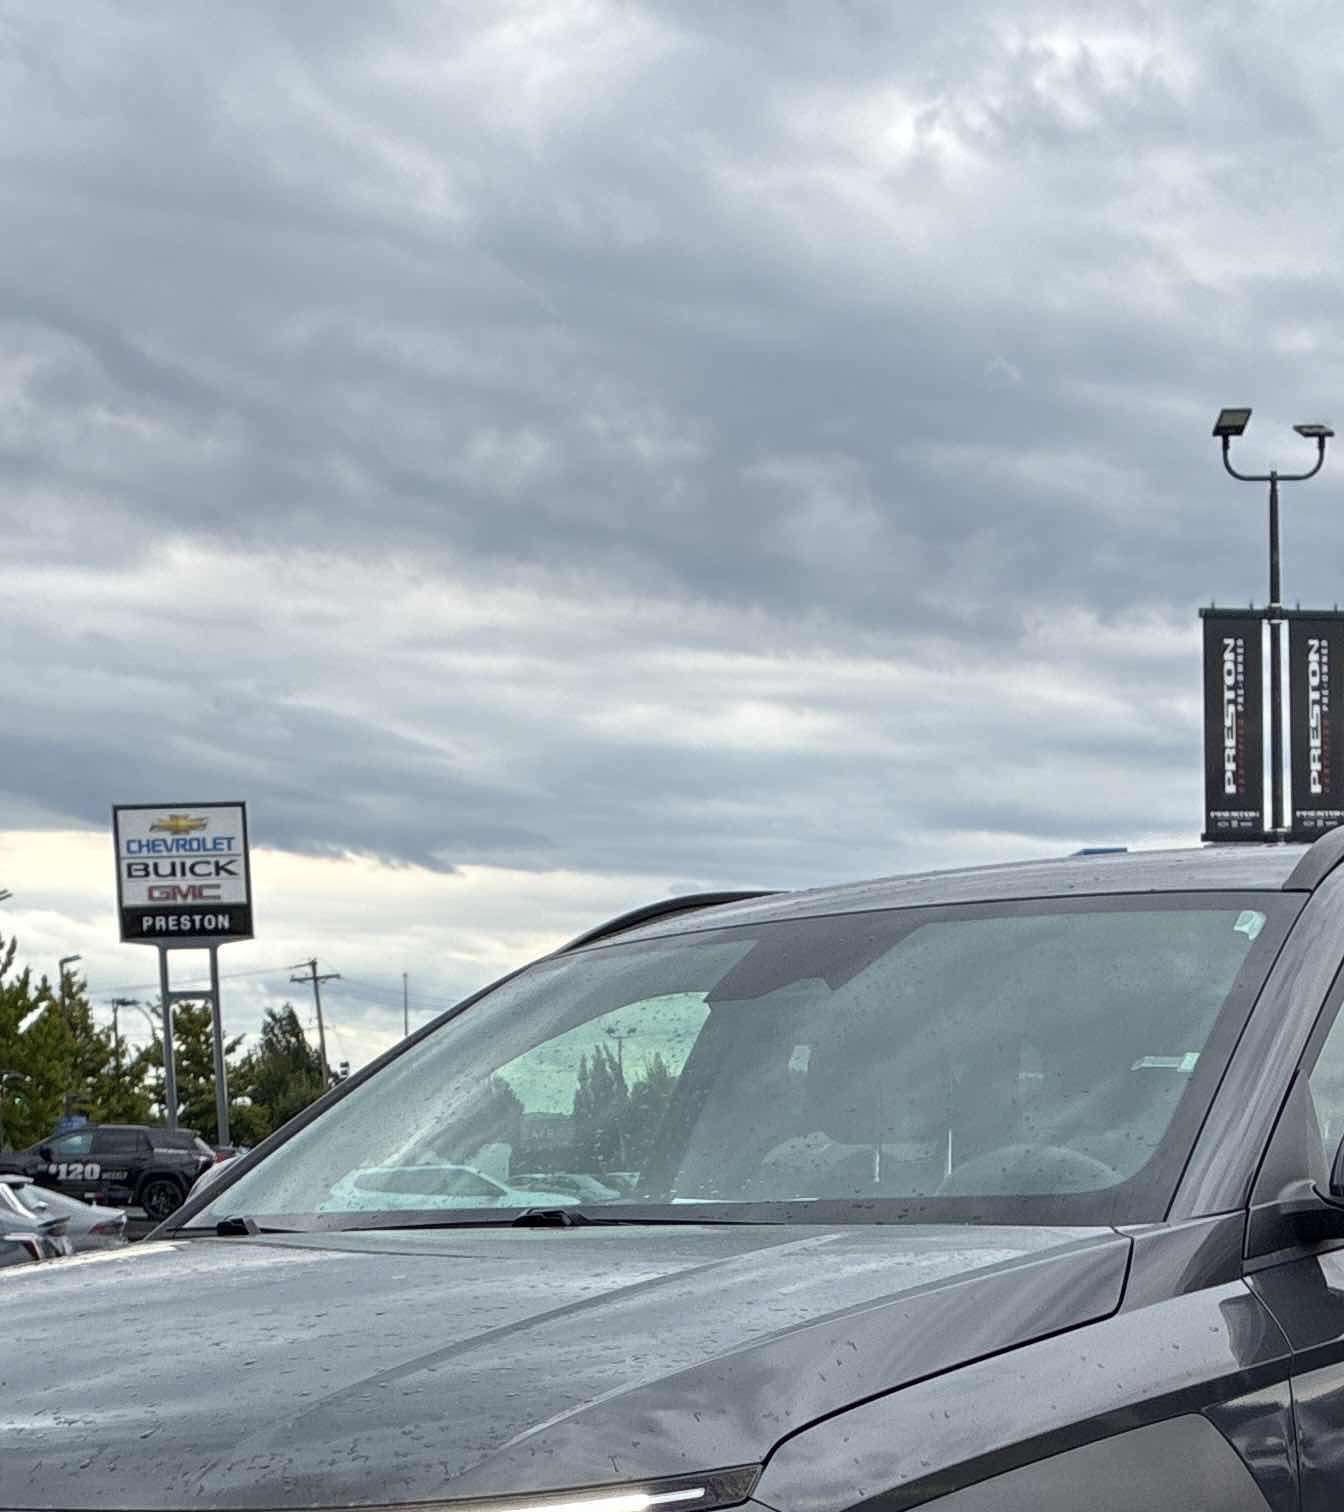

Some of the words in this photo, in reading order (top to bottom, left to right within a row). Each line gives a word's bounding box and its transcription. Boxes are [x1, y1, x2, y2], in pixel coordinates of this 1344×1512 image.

[1223, 638, 1237, 794] PRESTON
[1308, 639, 1322, 794] PRESTON
[126, 836, 236, 854] CHEVROLET
[126, 859, 239, 879] BUICK
[147, 883, 222, 902] GMC
[142, 914, 230, 932] PRESTON
